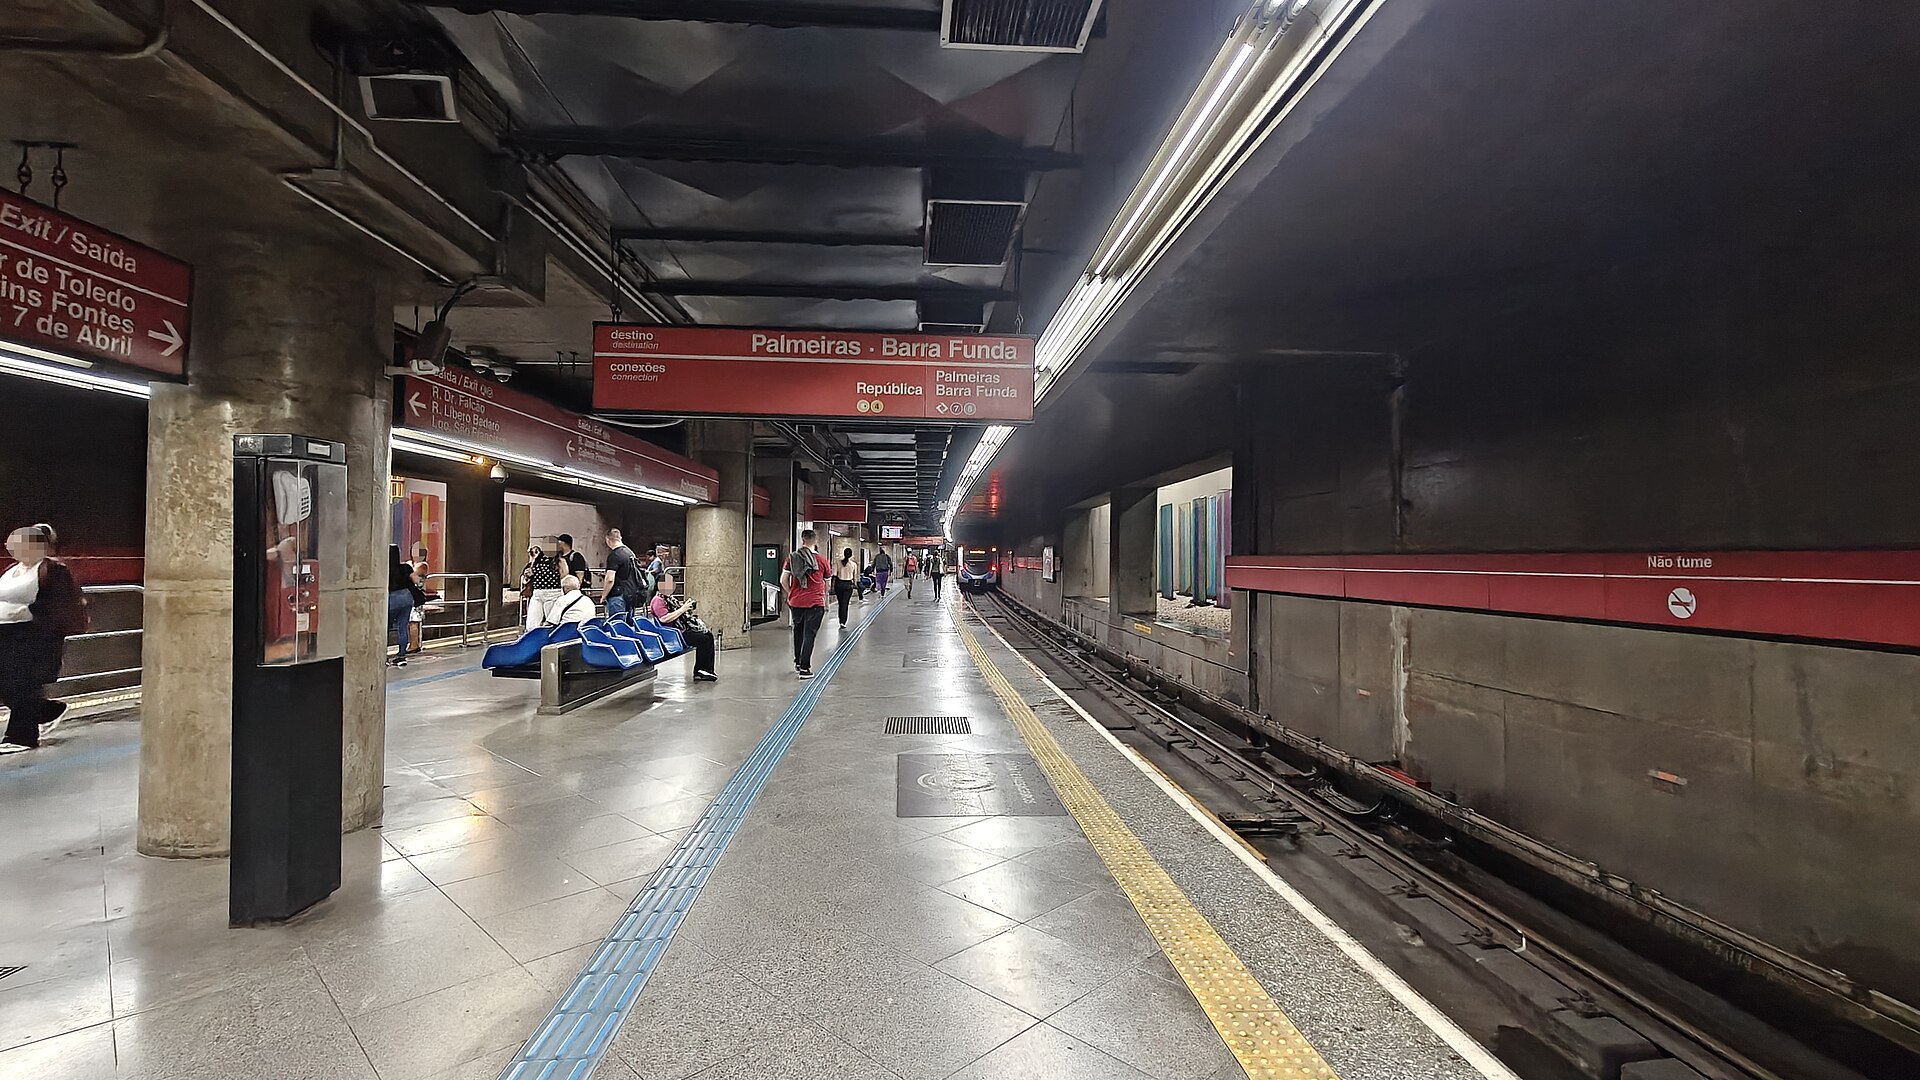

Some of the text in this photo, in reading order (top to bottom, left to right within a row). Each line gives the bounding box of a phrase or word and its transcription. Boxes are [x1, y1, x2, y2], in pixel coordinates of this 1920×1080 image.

[0, 203, 137, 273] Exit / Saída
[16, 257, 49, 284] de
[55, 267, 136, 312] Toledo
[52, 291, 134, 334] Fontes
[13, 305, 132, 356] 7 de Abril
[610, 330, 654, 341] destino
[612, 341, 659, 350] destination
[752, 333, 861, 356] Palmeiras
[882, 337, 941, 358] Barra
[949, 339, 1017, 360] Funda
[610, 362, 666, 373] conexões
[611, 373, 658, 382] connection
[936, 370, 1000, 384] Palmeiras
[856, 381, 923, 397] República
[936, 384, 1017, 398] Barra Funda
[432, 385, 486, 415] R. Dr. Falcão
[432, 400, 442, 415] R.
[1647, 555, 1713, 568] Não fume
